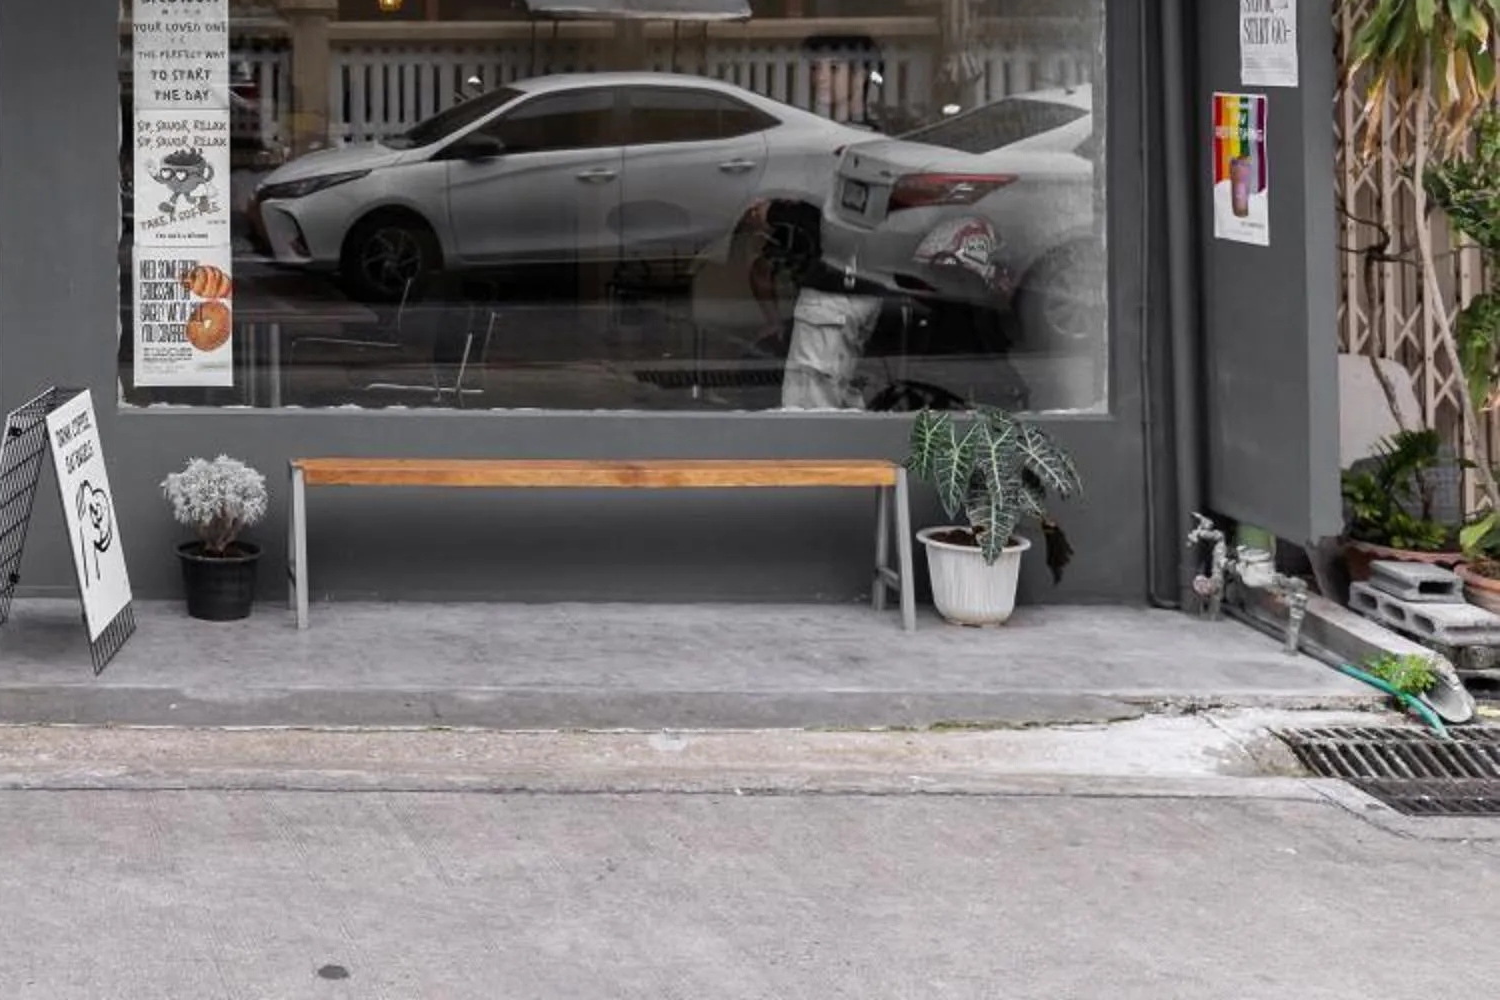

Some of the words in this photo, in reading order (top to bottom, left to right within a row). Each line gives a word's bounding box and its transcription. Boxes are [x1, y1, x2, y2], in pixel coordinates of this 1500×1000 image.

[134, 22, 162, 34] YOUR
[166, 22, 201, 34] LOVED
[151, 69, 168, 81] TO
[171, 67, 212, 81] START
[154, 89, 181, 101] THE
[185, 89, 210, 102] DAY
